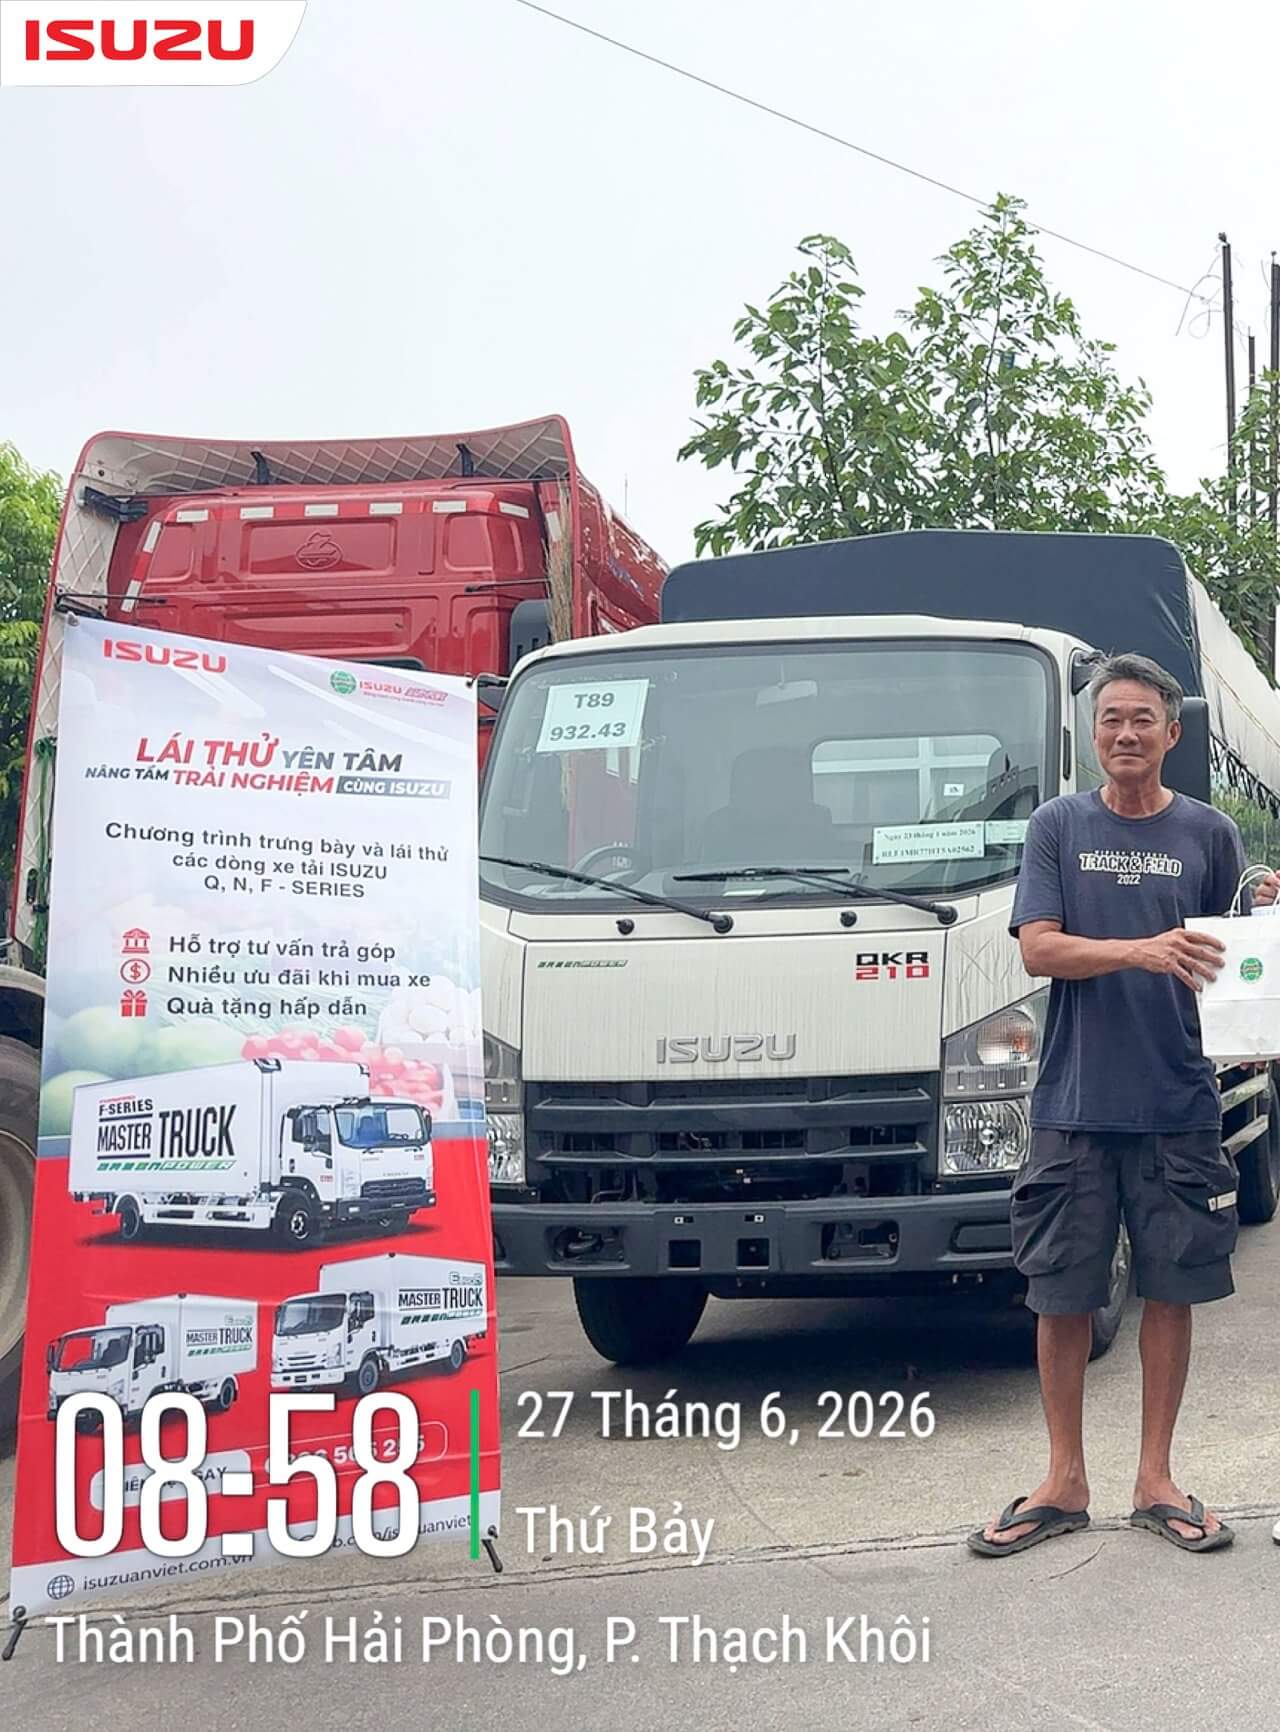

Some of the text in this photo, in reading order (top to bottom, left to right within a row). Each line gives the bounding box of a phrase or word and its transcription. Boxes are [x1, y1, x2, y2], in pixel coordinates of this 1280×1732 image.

[103, 639, 227, 674] ISUZU
[360, 681, 402, 694] ISUZU
[574, 692, 614, 708] T89
[549, 722, 626, 741] 932.43
[136, 732, 403, 772] LÁI THỬ YÊN TÂM
[85, 765, 130, 779] NÂNG
[231, 771, 334, 797] NGHIỆM
[343, 778, 386, 794] CÙNG
[389, 780, 444, 796] ISUZU
[105, 822, 449, 862] Chương trình trưng bày và lái thử
[172, 852, 387, 879] các dòng xe tải ISUZU
[1079, 852, 1128, 872] TRACK
[1130, 856, 1143, 873] &
[204, 875, 225, 892] Q,
[233, 877, 253, 894] N,
[261, 879, 272, 892] F
[292, 880, 365, 898] SERIES
[1117, 873, 1141, 885] 2022
[170, 933, 396, 963] Hỗ trợ tư vấn trả góp
[856, 952, 928, 966] QKR
[168, 964, 431, 987] Nhiều ưu đãi khi mua xe
[856, 965, 929, 980] 210
[167, 996, 367, 1019] Quà tặng hấp dẫn
[656, 1031, 797, 1065] ISUZU
[99, 1099, 153, 1116] F-SERIES
[97, 1104, 237, 1158] MASTER TRUCK
[398, 1287, 483, 1309] MASTER TRUCK
[186, 1327, 253, 1345] MASTER TRUCK
